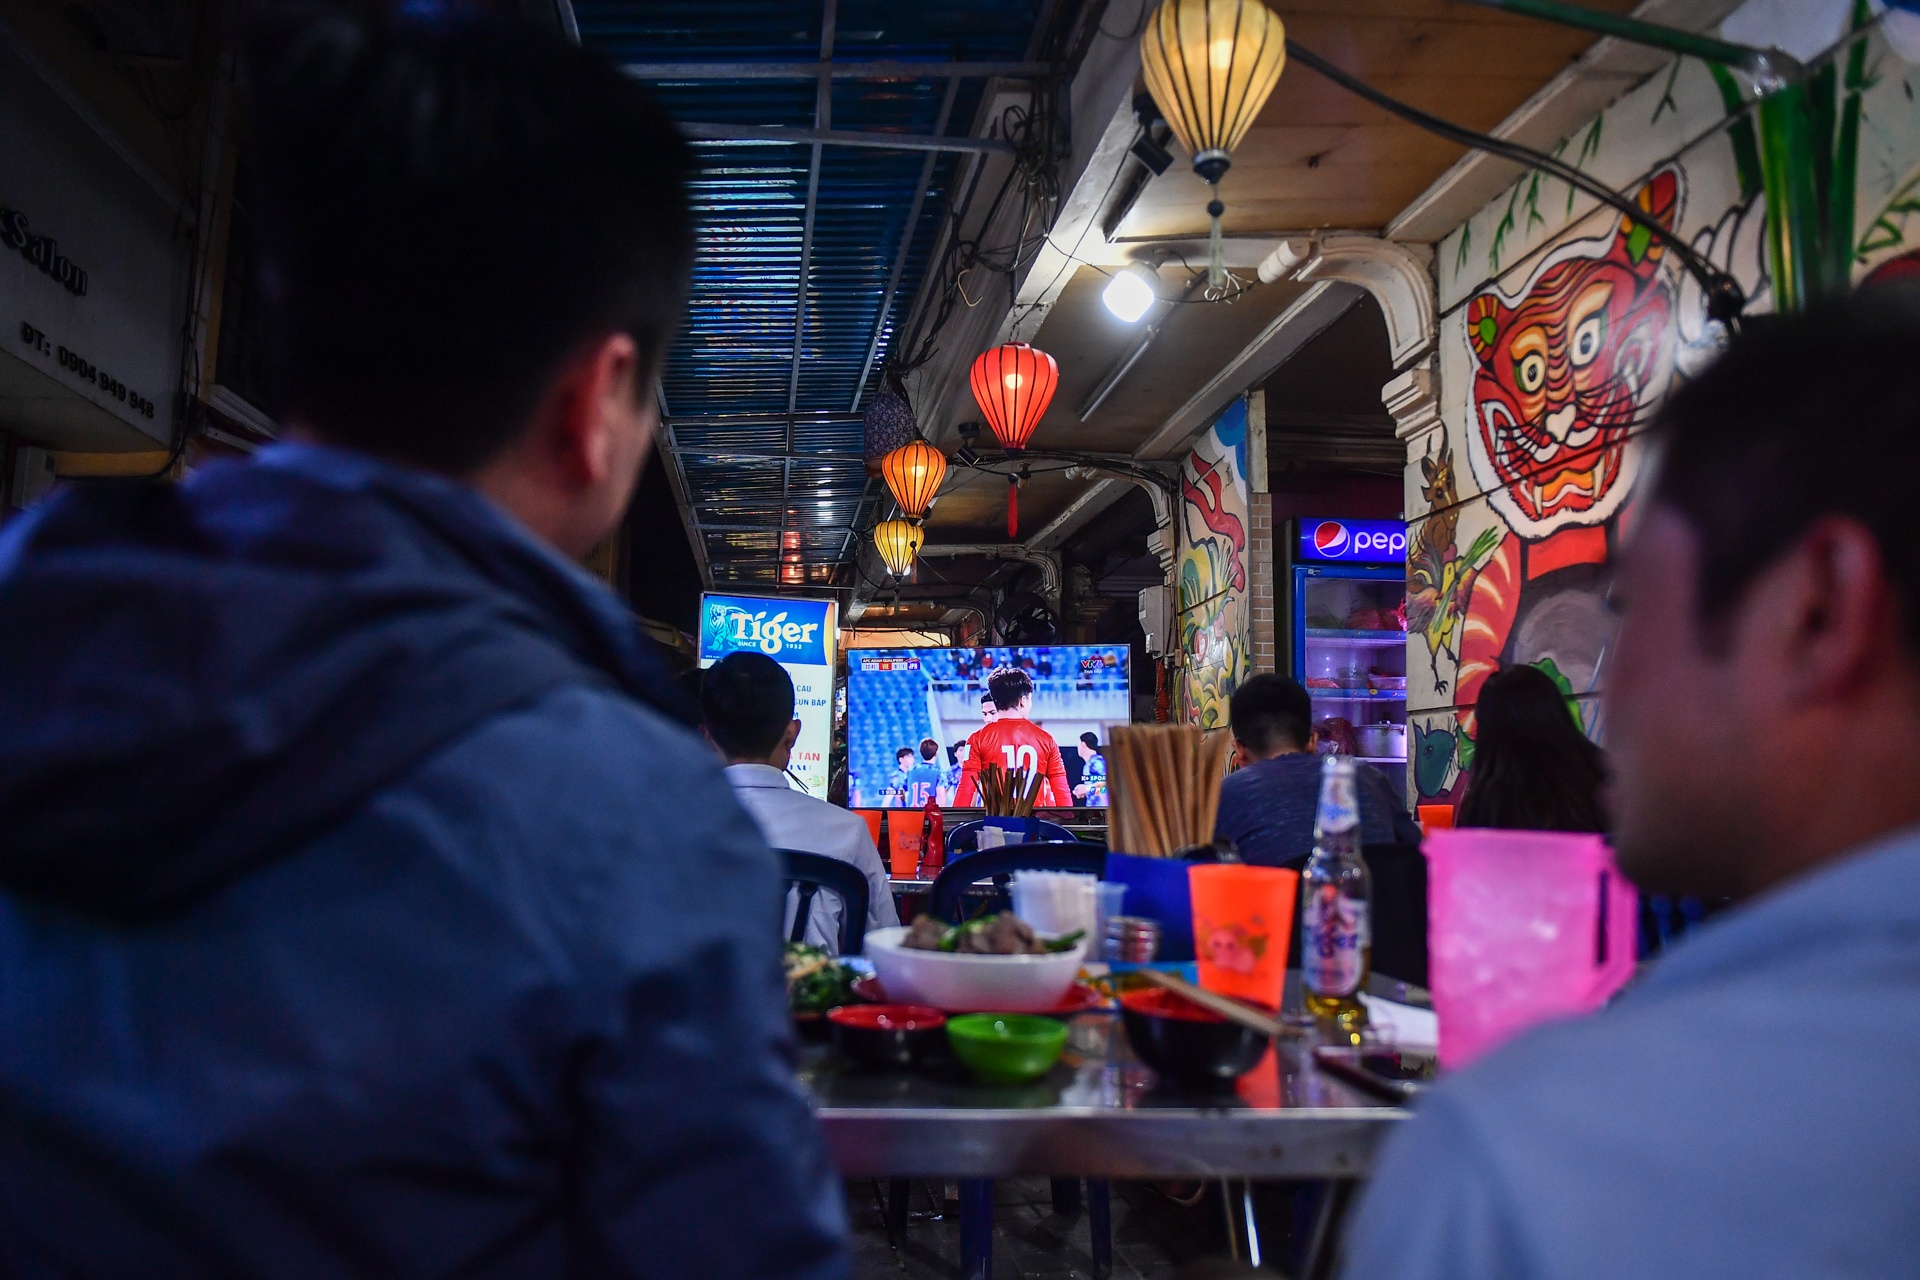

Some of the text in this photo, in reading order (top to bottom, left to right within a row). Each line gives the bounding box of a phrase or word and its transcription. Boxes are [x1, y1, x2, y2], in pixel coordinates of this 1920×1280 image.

[10, 210, 88, 297] Salon
[56, 345, 98, 385] 0904
[98, 372, 127, 402] 949
[128, 391, 155, 419] 948
[729, 610, 819, 655] Tiger
[1080, 659, 1104, 669] VTV6
[910, 781, 931, 807] 15
[1001, 744, 1038, 800] 10
